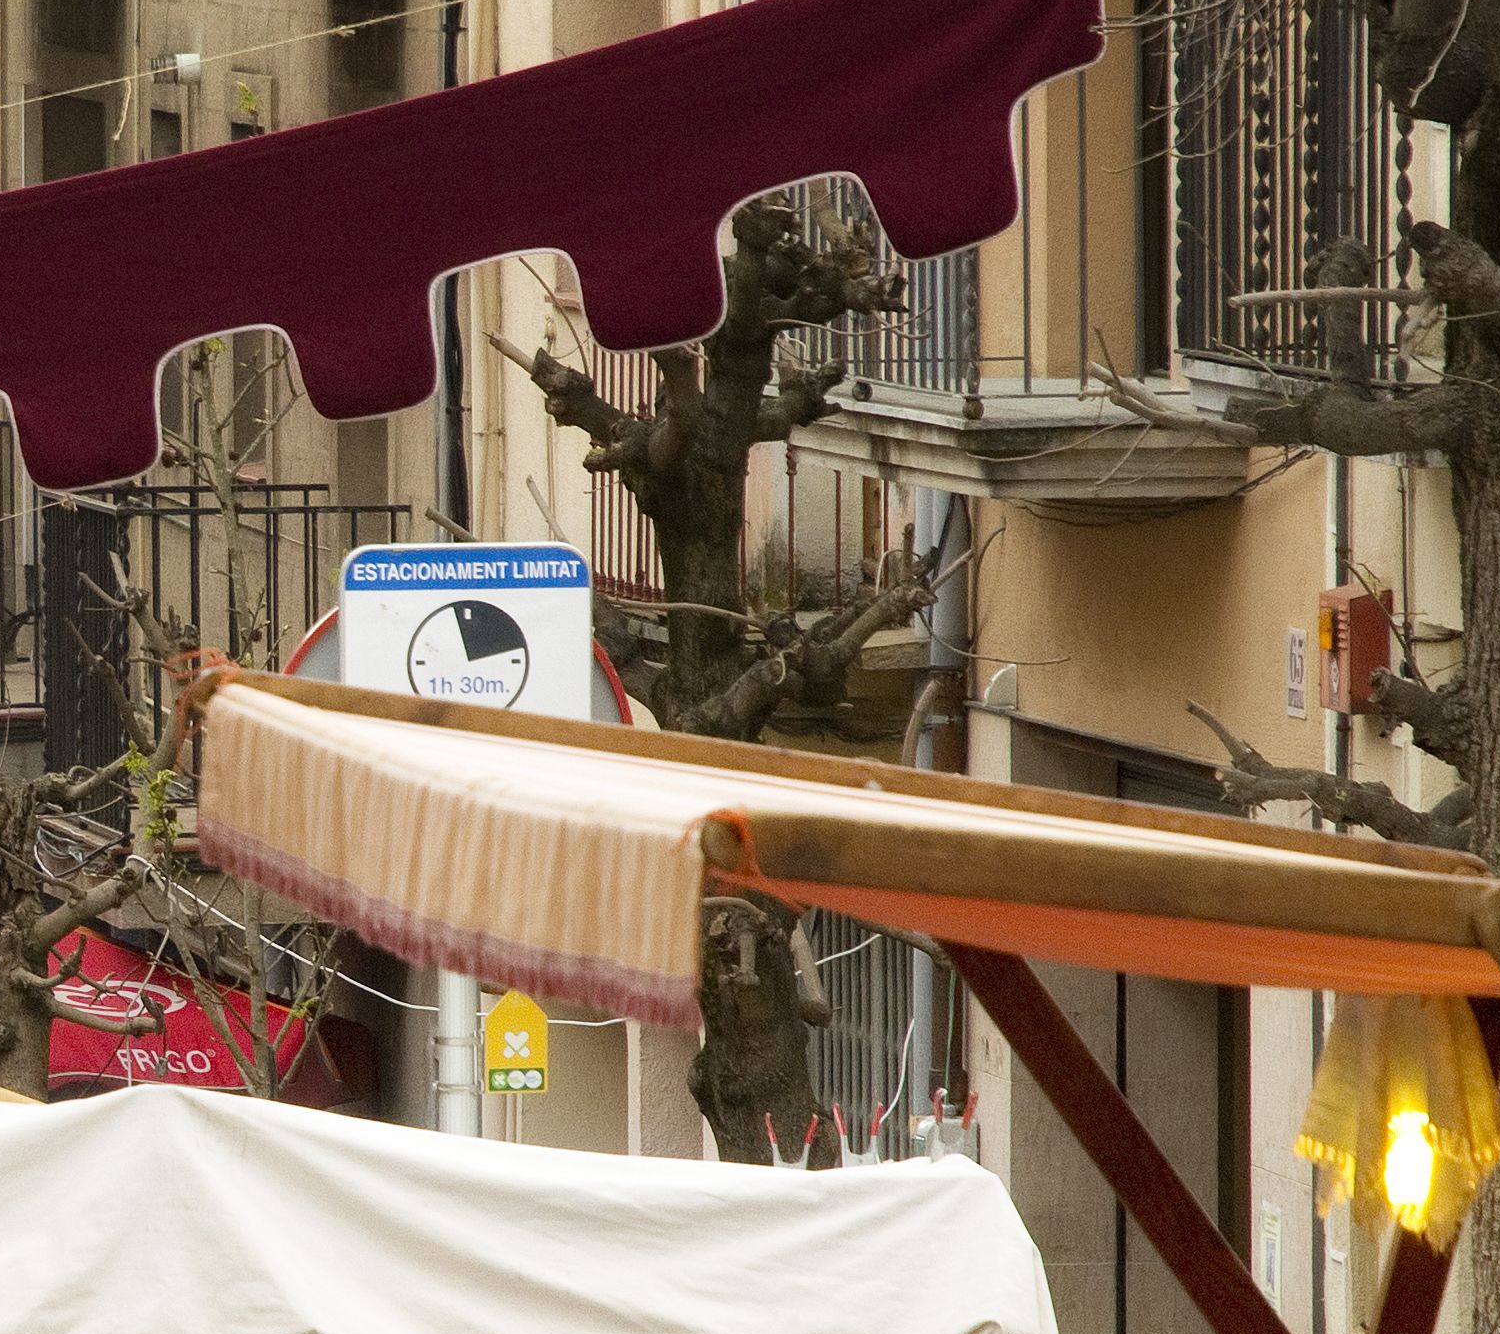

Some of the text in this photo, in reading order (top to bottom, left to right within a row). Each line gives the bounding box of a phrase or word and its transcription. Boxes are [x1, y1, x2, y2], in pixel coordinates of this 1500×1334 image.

[352, 560, 582, 583] ESTACIONAMENT LIMITAT
[428, 677, 510, 694] 1h 30m.
